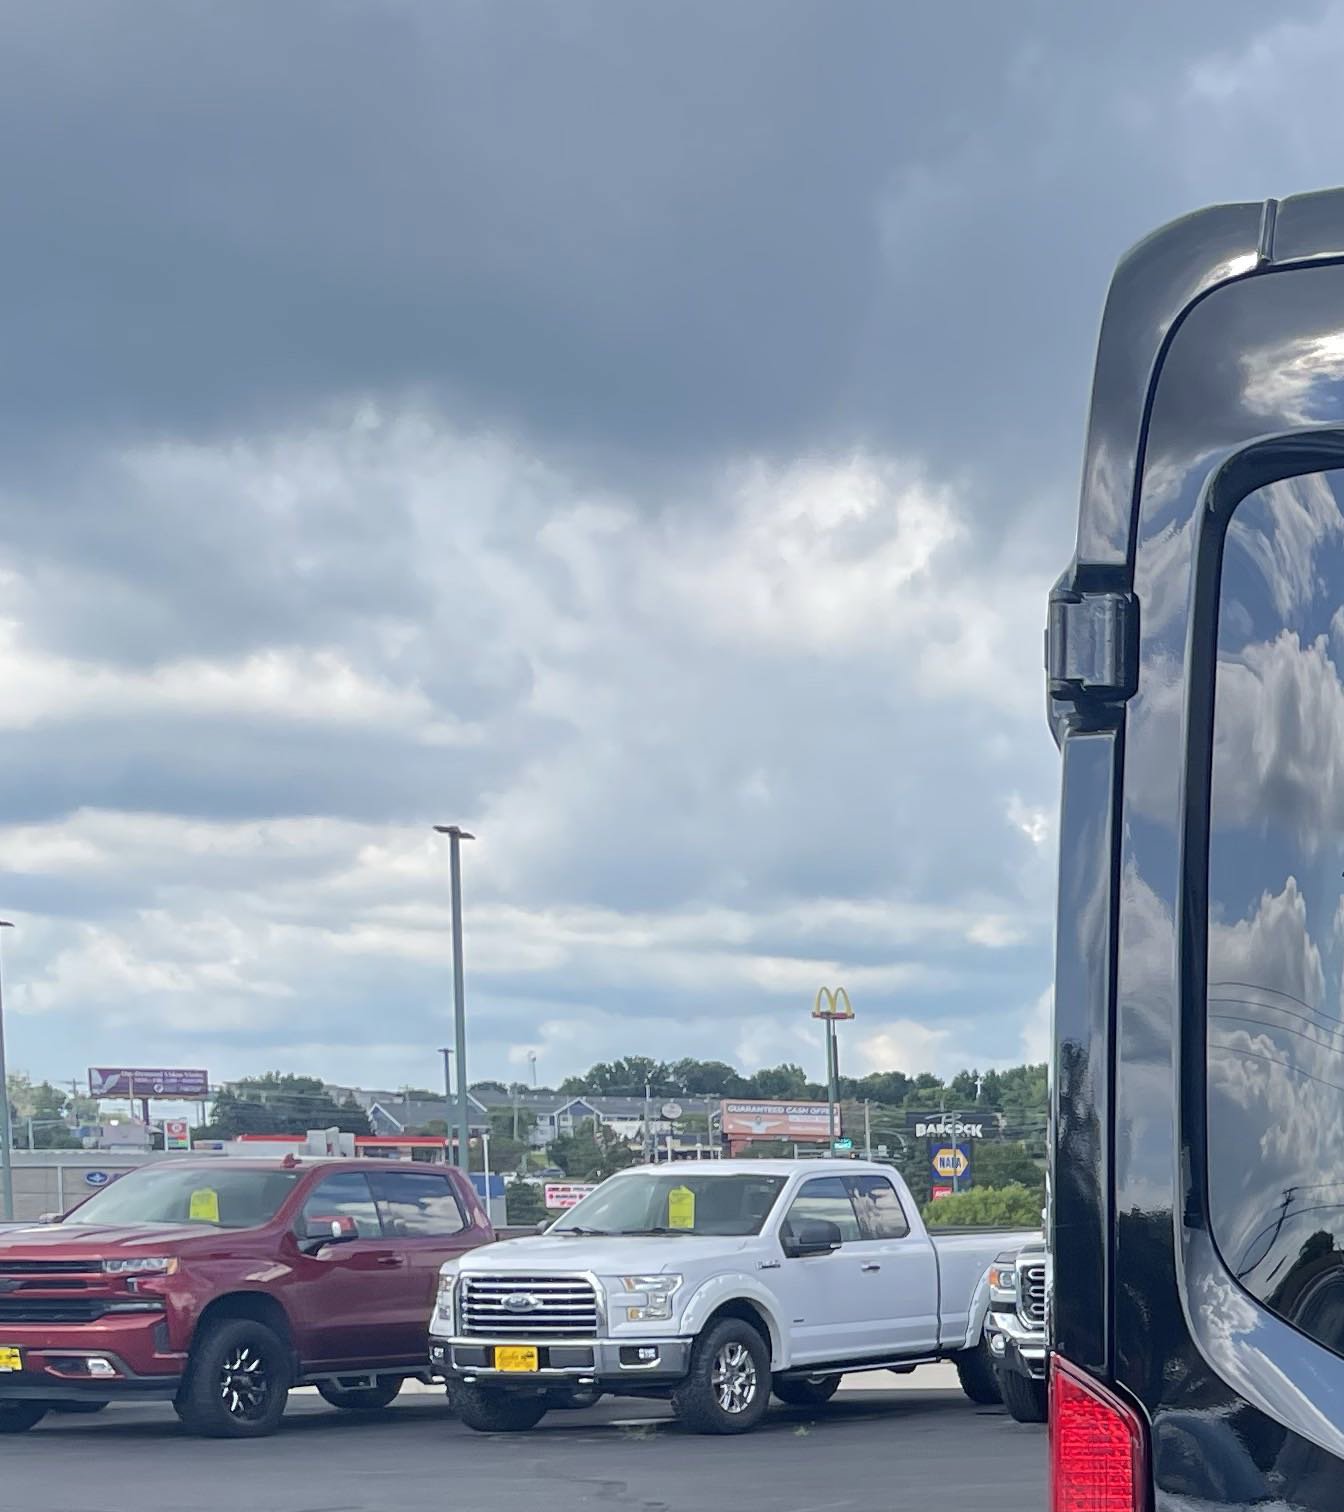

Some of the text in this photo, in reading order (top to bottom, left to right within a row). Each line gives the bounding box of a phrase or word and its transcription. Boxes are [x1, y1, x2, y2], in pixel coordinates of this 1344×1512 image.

[727, 1105, 837, 1115] GUARANTEED CASH OFFE
[916, 1123, 983, 1138] BABCOCK
